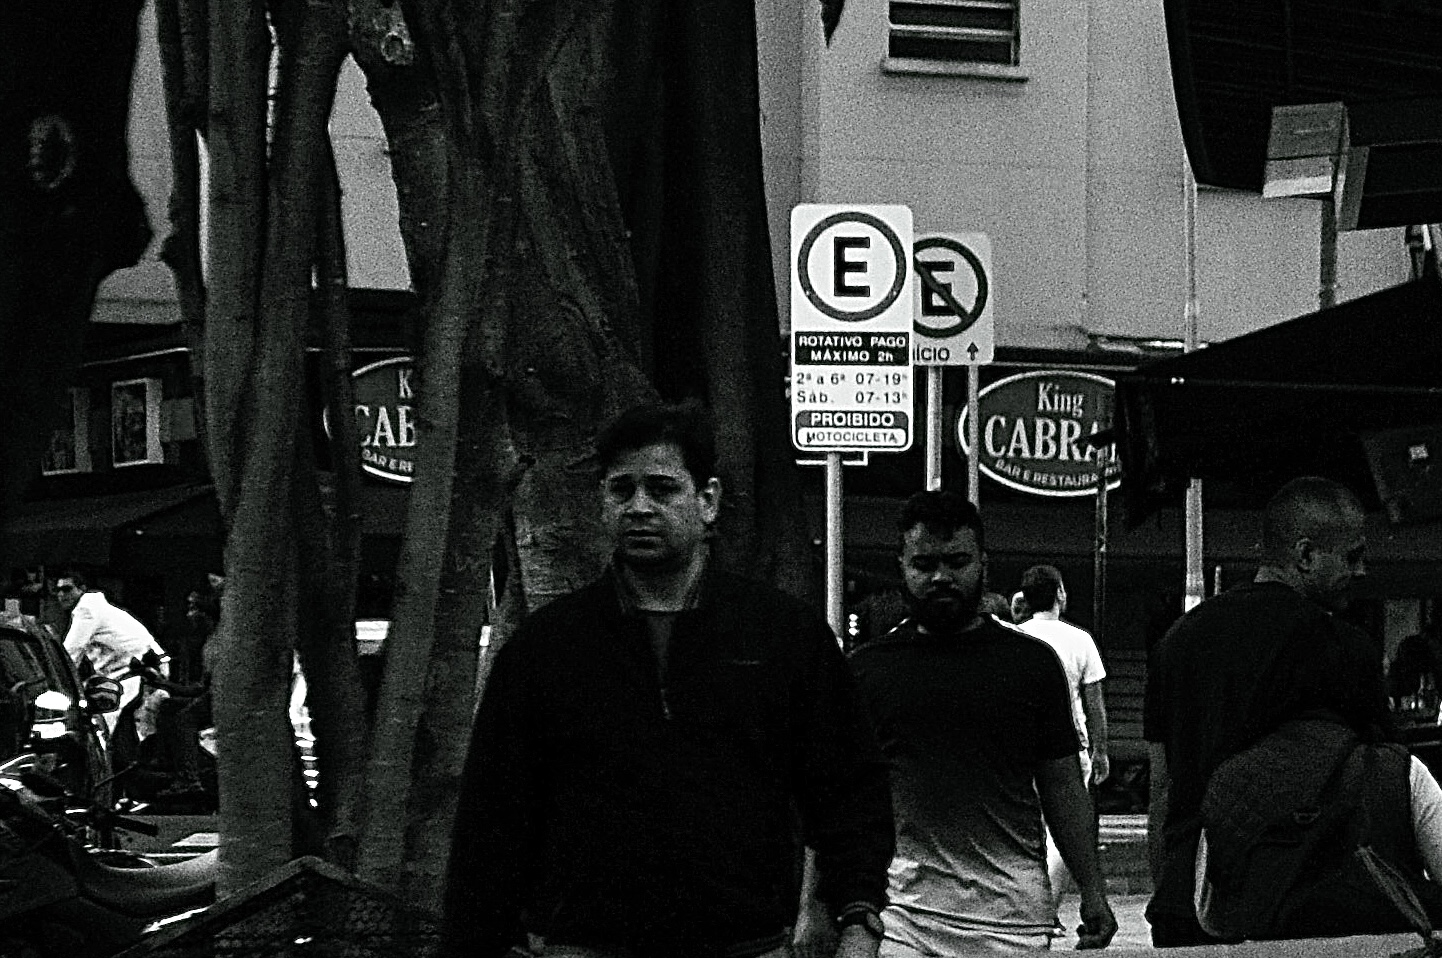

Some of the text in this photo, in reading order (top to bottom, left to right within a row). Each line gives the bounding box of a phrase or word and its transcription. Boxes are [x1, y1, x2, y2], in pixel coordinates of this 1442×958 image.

[833, 236, 871, 298] E
[798, 335, 906, 348] ROTATIVO PAGO
[810, 348, 894, 363] MÁXIMO 2h
[912, 344, 950, 362] ÍCIO
[816, 375, 825, 386] a
[1037, 382, 1084, 418] King
[354, 404, 416, 447] CAB
[810, 412, 895, 428] PROIBIDO
[806, 431, 898, 444] MOTOCICLETA
[995, 458, 1021, 479] BAR
[1022, 469, 1032, 482] E
